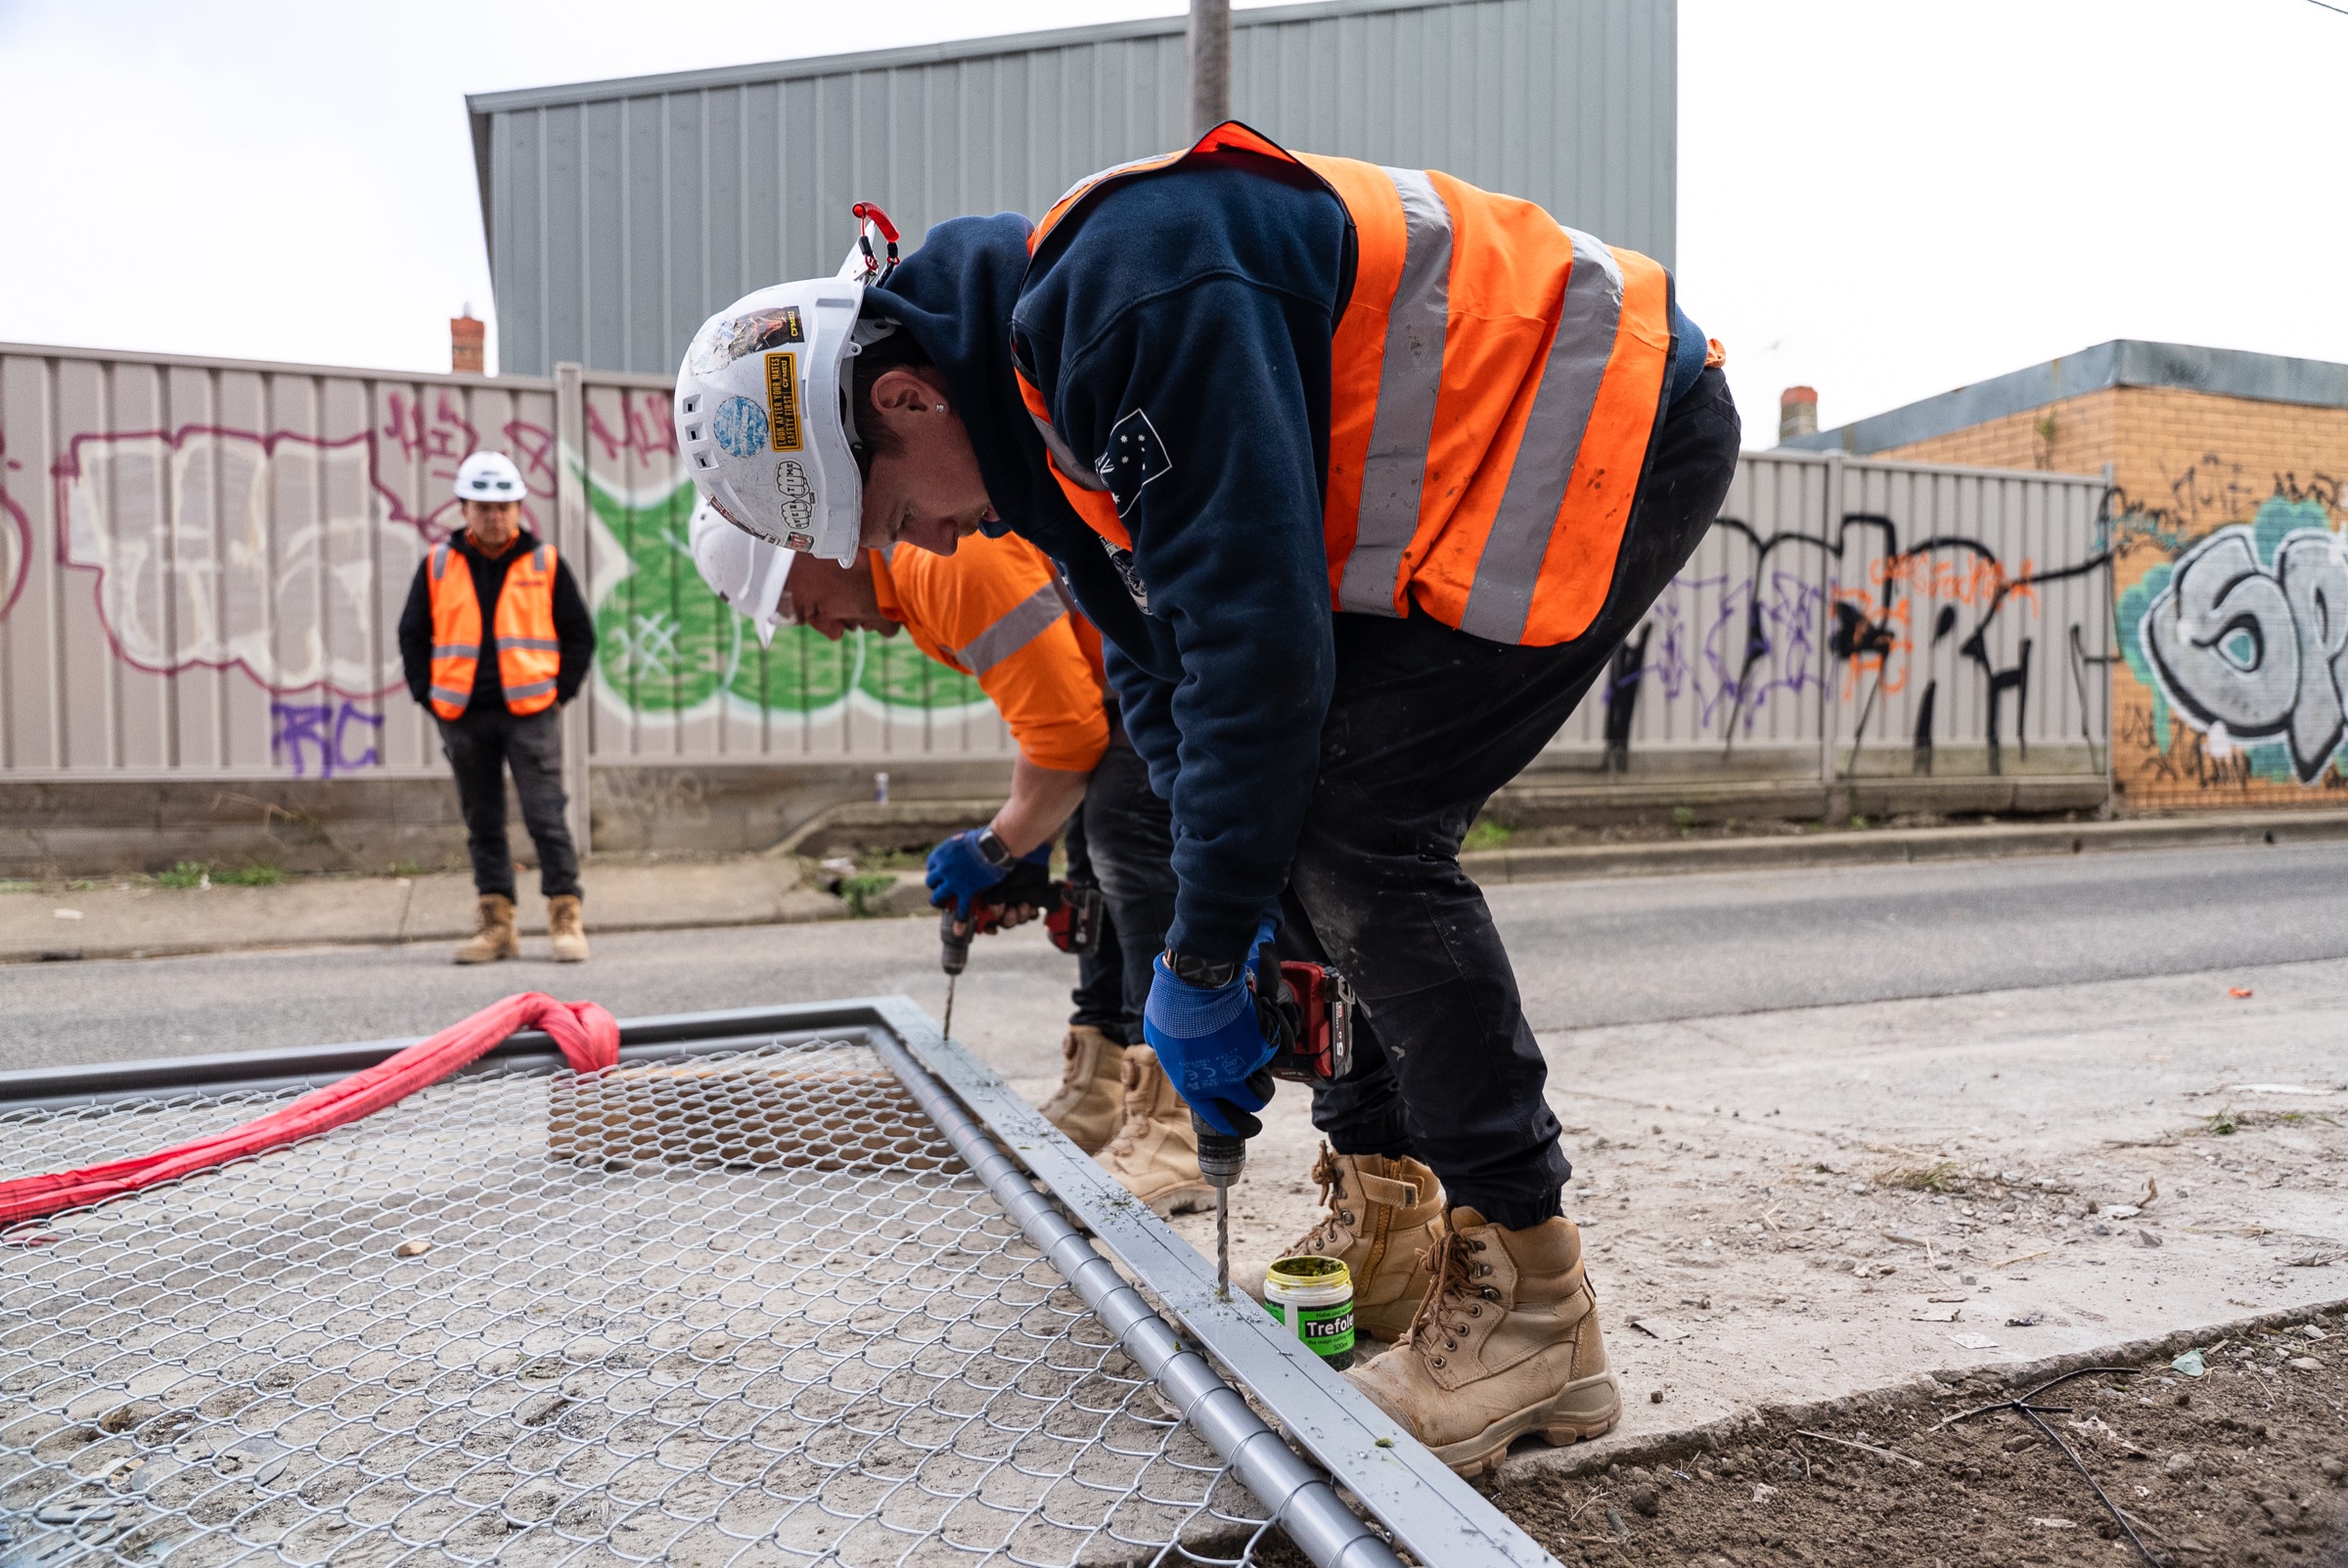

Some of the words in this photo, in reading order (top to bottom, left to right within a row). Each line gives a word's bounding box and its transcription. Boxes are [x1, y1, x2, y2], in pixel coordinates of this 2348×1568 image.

[788, 311, 798, 336] CFMEU
[771, 357, 780, 381] MATES
[773, 381, 782, 400] YOUR
[774, 402, 785, 425] AFTER
[784, 394, 793, 416] FIRST
[777, 426, 787, 445] LOOK
[786, 418, 796, 444] SAFETY
[1307, 1314, 1354, 1336] Trefole
[1333, 1342, 1347, 1351] 500ml
